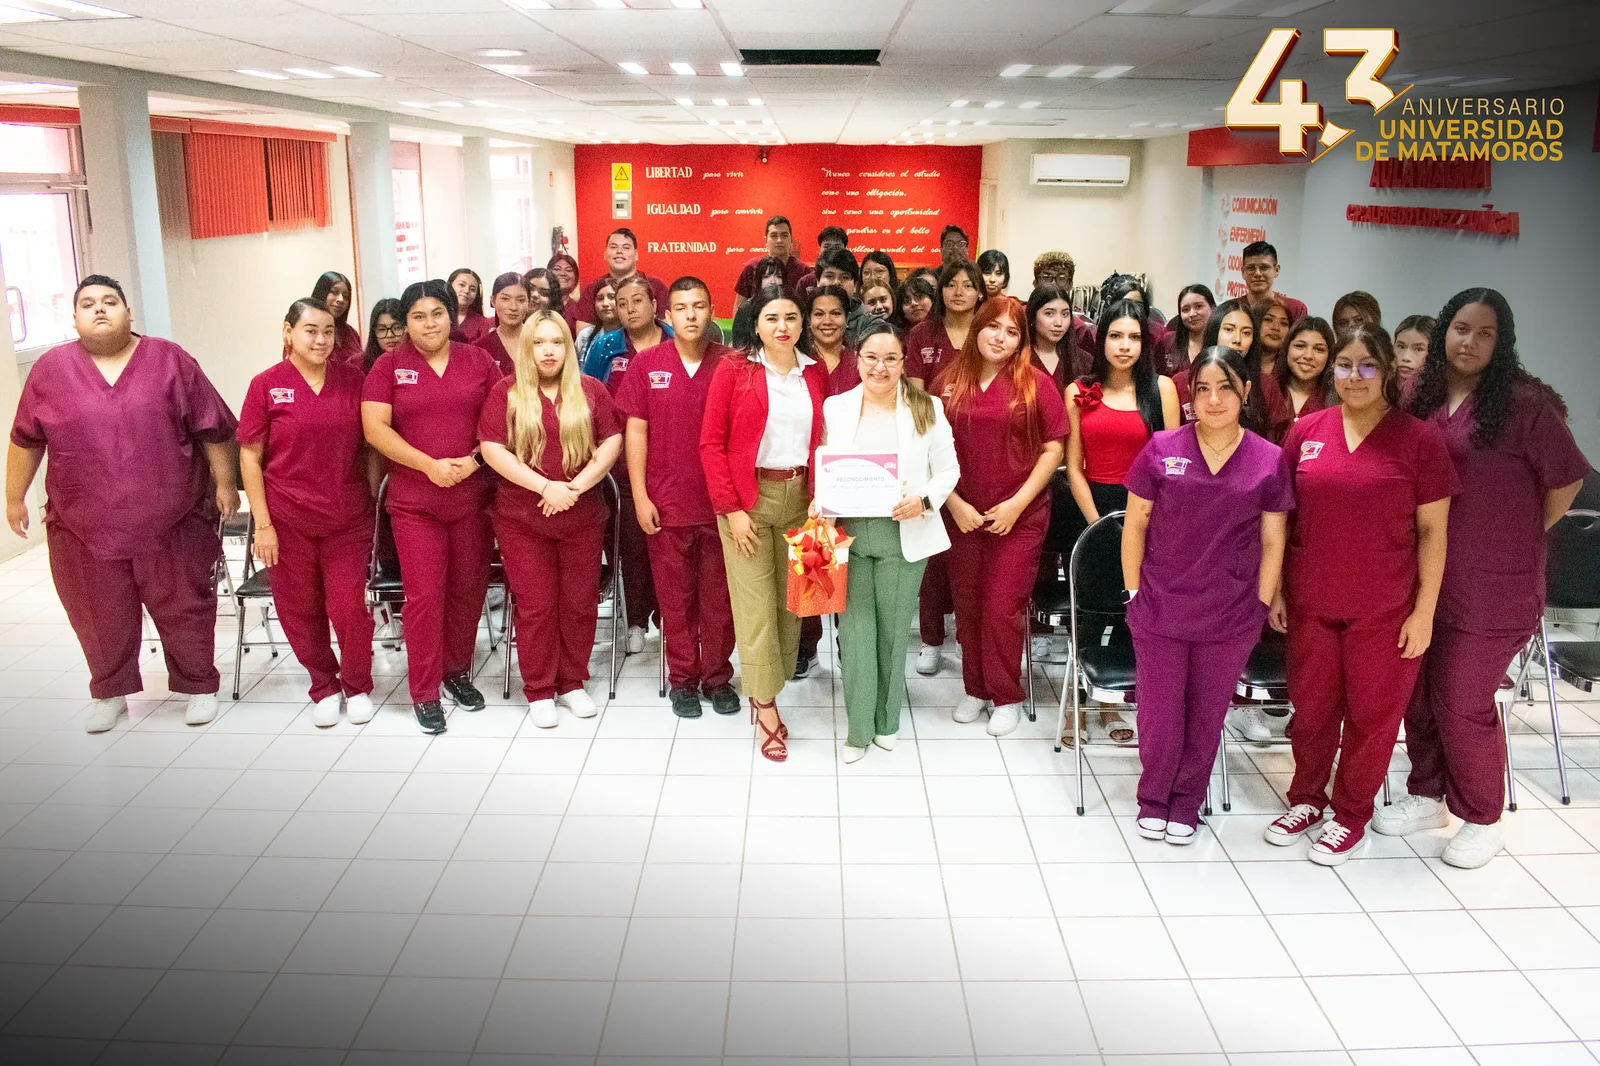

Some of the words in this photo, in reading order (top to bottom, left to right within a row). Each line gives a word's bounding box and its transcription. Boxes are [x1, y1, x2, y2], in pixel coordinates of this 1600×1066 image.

[645, 166, 693, 179] LIBERTAD
[858, 170, 896, 178] consideres
[900, 169, 909, 178] el
[913, 169, 940, 178] estudio
[646, 203, 701, 215] IGUALDAD
[890, 207, 941, 219] oportunidad
[846, 226, 878, 236] penetrar
[895, 226, 905, 234] el
[909, 226, 930, 235] bello
[647, 241, 717, 253] FRATERNIDAD
[879, 245, 906, 253] mundo
[910, 245, 926, 253] del
